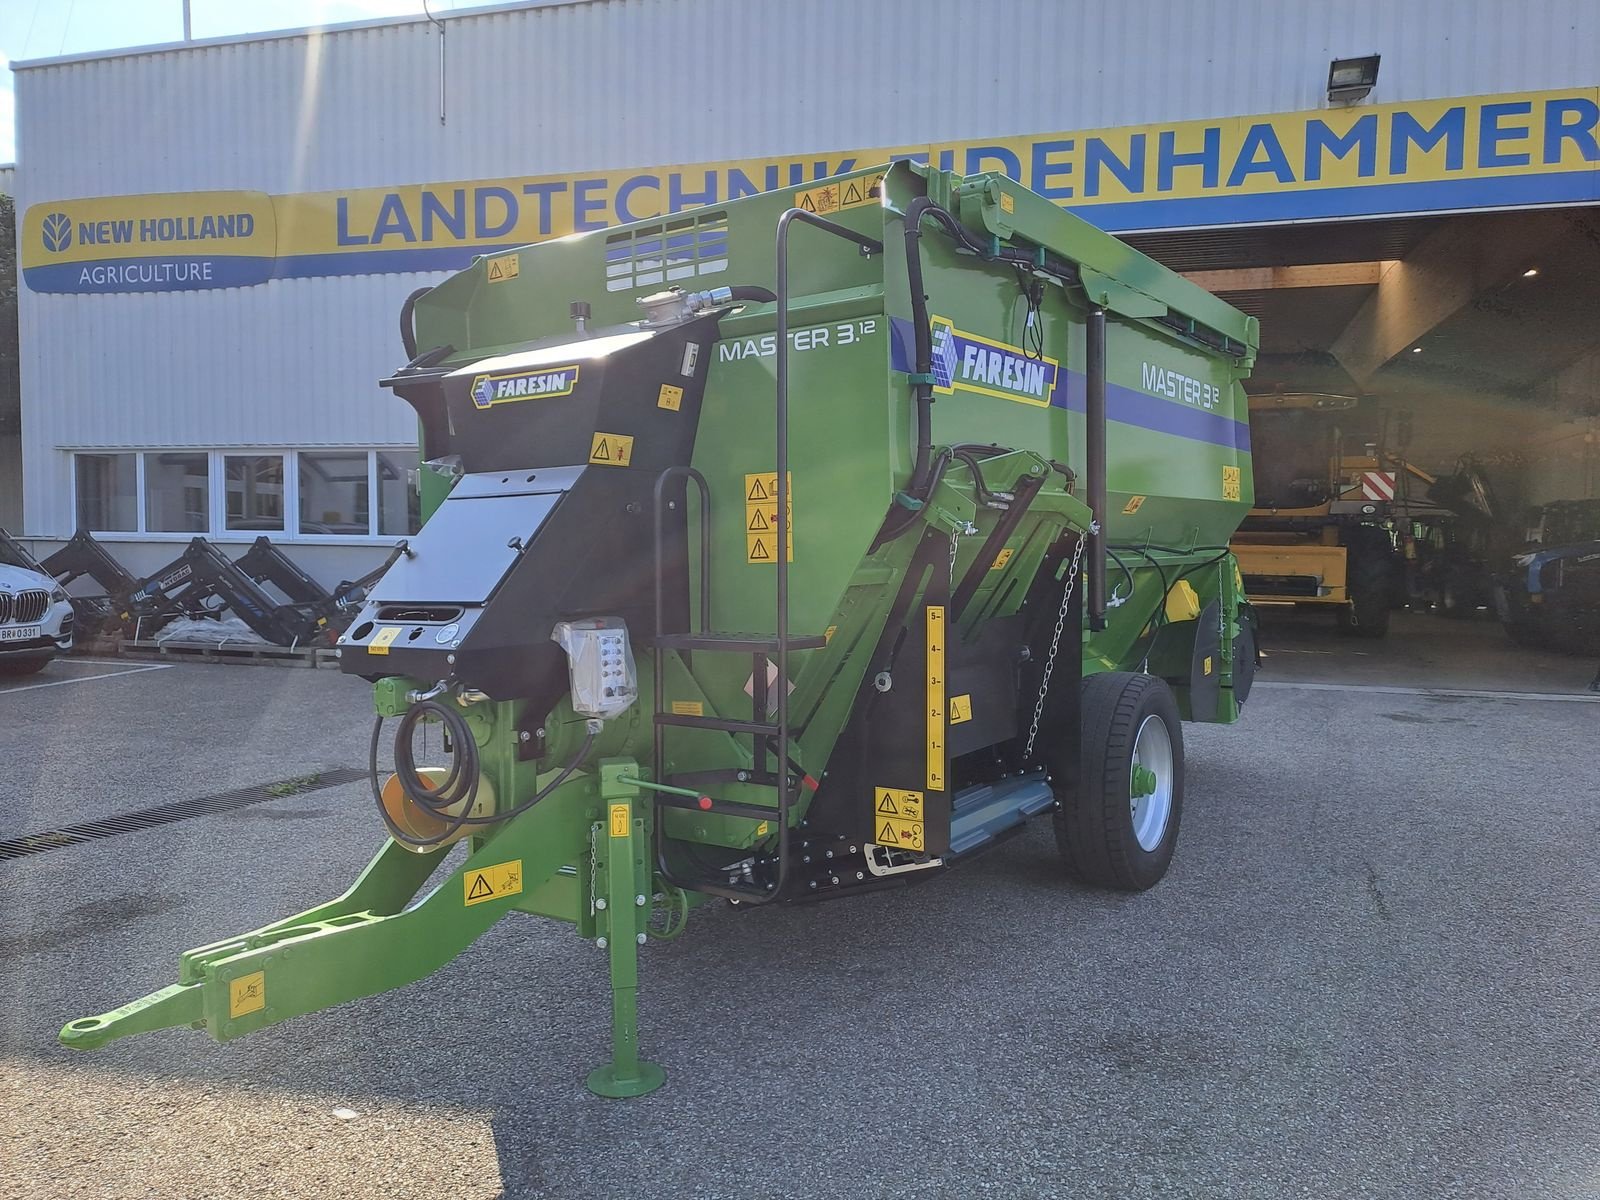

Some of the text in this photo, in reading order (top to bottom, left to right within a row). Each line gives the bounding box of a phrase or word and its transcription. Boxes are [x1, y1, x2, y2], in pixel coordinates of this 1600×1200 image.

[889, 97, 1600, 199] DENHAMMER
[79, 213, 254, 245] NEW HOLLAND
[79, 262, 213, 285] AGRICULTURE
[719, 328, 829, 362] MASER
[496, 372, 566, 398] FARESIN
[961, 344, 1045, 396] FARESIN
[1142, 362, 1201, 406] MASTER
[2, 630, 12, 639] BR
